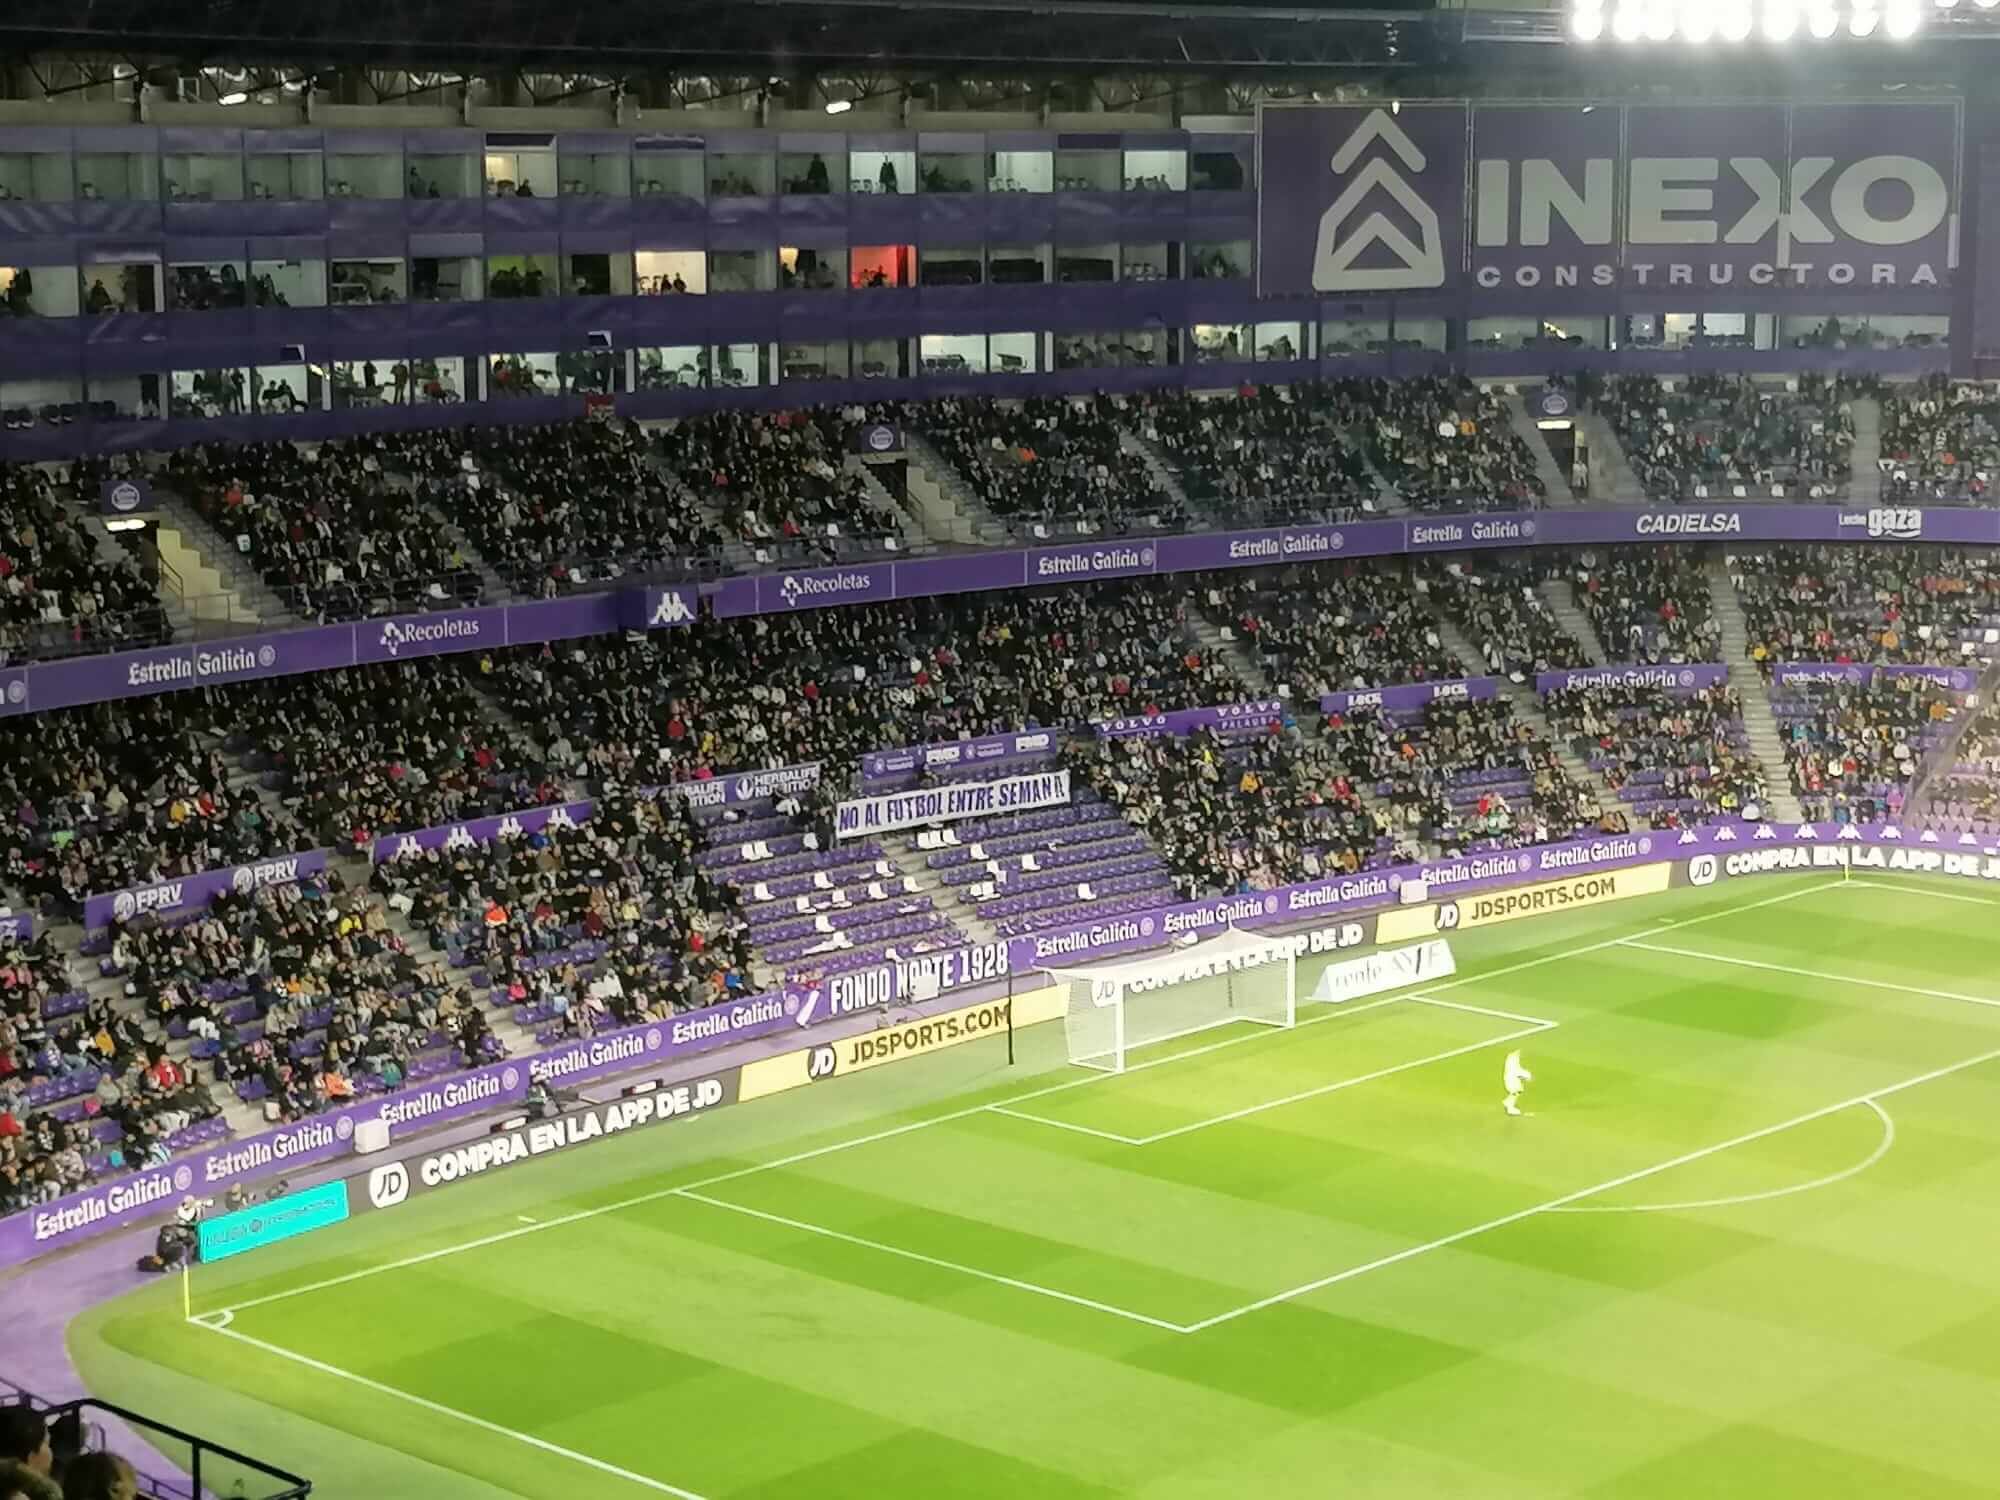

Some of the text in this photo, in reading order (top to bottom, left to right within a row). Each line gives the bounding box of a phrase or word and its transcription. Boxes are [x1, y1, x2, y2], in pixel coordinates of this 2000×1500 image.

[1477, 154, 1948, 246] INEXO
[1477, 262, 1938, 288] CONSTRUCTORA
[1411, 520, 1519, 544] Estrella Galicia
[1636, 512, 1741, 534] CADIELSA
[1867, 508, 1922, 537] gaza
[1229, 533, 1329, 558] Estrella Galicia
[1037, 549, 1139, 576] Estrella Galicia
[802, 571, 871, 594] Recoletas
[404, 618, 480, 642] Recoletas
[128, 647, 256, 686] Estrella Galicia
[1101, 715, 1166, 732] VOLVO
[1217, 702, 1281, 717] VOLVO
[839, 806, 859, 831] NO
[864, 802, 881, 826] AL
[887, 794, 946, 823] FUTBOL
[948, 787, 995, 815] ENTRE
[1540, 839, 1636, 870] Estrella Galicia
[1725, 847, 1810, 875] COMPRA
[1813, 846, 1846, 867] EN
[1852, 846, 1883, 867] LA
[1889, 848, 1941, 872] APP
[1944, 852, 1979, 876] DE
[253, 858, 298, 886] FPRV
[1420, 855, 1516, 886] Estrella Galicia
[136, 883, 183, 914] FPRV
[1289, 876, 1387, 910] Estrella Galicia
[1437, 876, 1617, 929] JD JDSPORTS.COM
[1163, 910, 1216, 934] Estrella
[1036, 920, 1139, 958] Estrella Galicia
[1310, 927, 1337, 953] DE
[1338, 923, 1364, 948] JD
[831, 967, 891, 1015] FONDO
[960, 940, 1009, 982] 1928
[671, 998, 782, 1046] Estrella Galicia
[589, 1034, 644, 1067] Galicia
[810, 1002, 1011, 1076] JD JDSPORTS.COM
[380, 1073, 499, 1126] Estrella Galicia
[421, 1133, 528, 1186] COMPRA
[530, 1119, 569, 1155] EN
[569, 1111, 603, 1145] LA
[604, 1098, 655, 1134] APP
[656, 1087, 690, 1119] DE
[691, 1079, 723, 1110] JD
[206, 1121, 334, 1182] Estrella Galicia
[35, 1174, 173, 1241] Estrella Galicia
